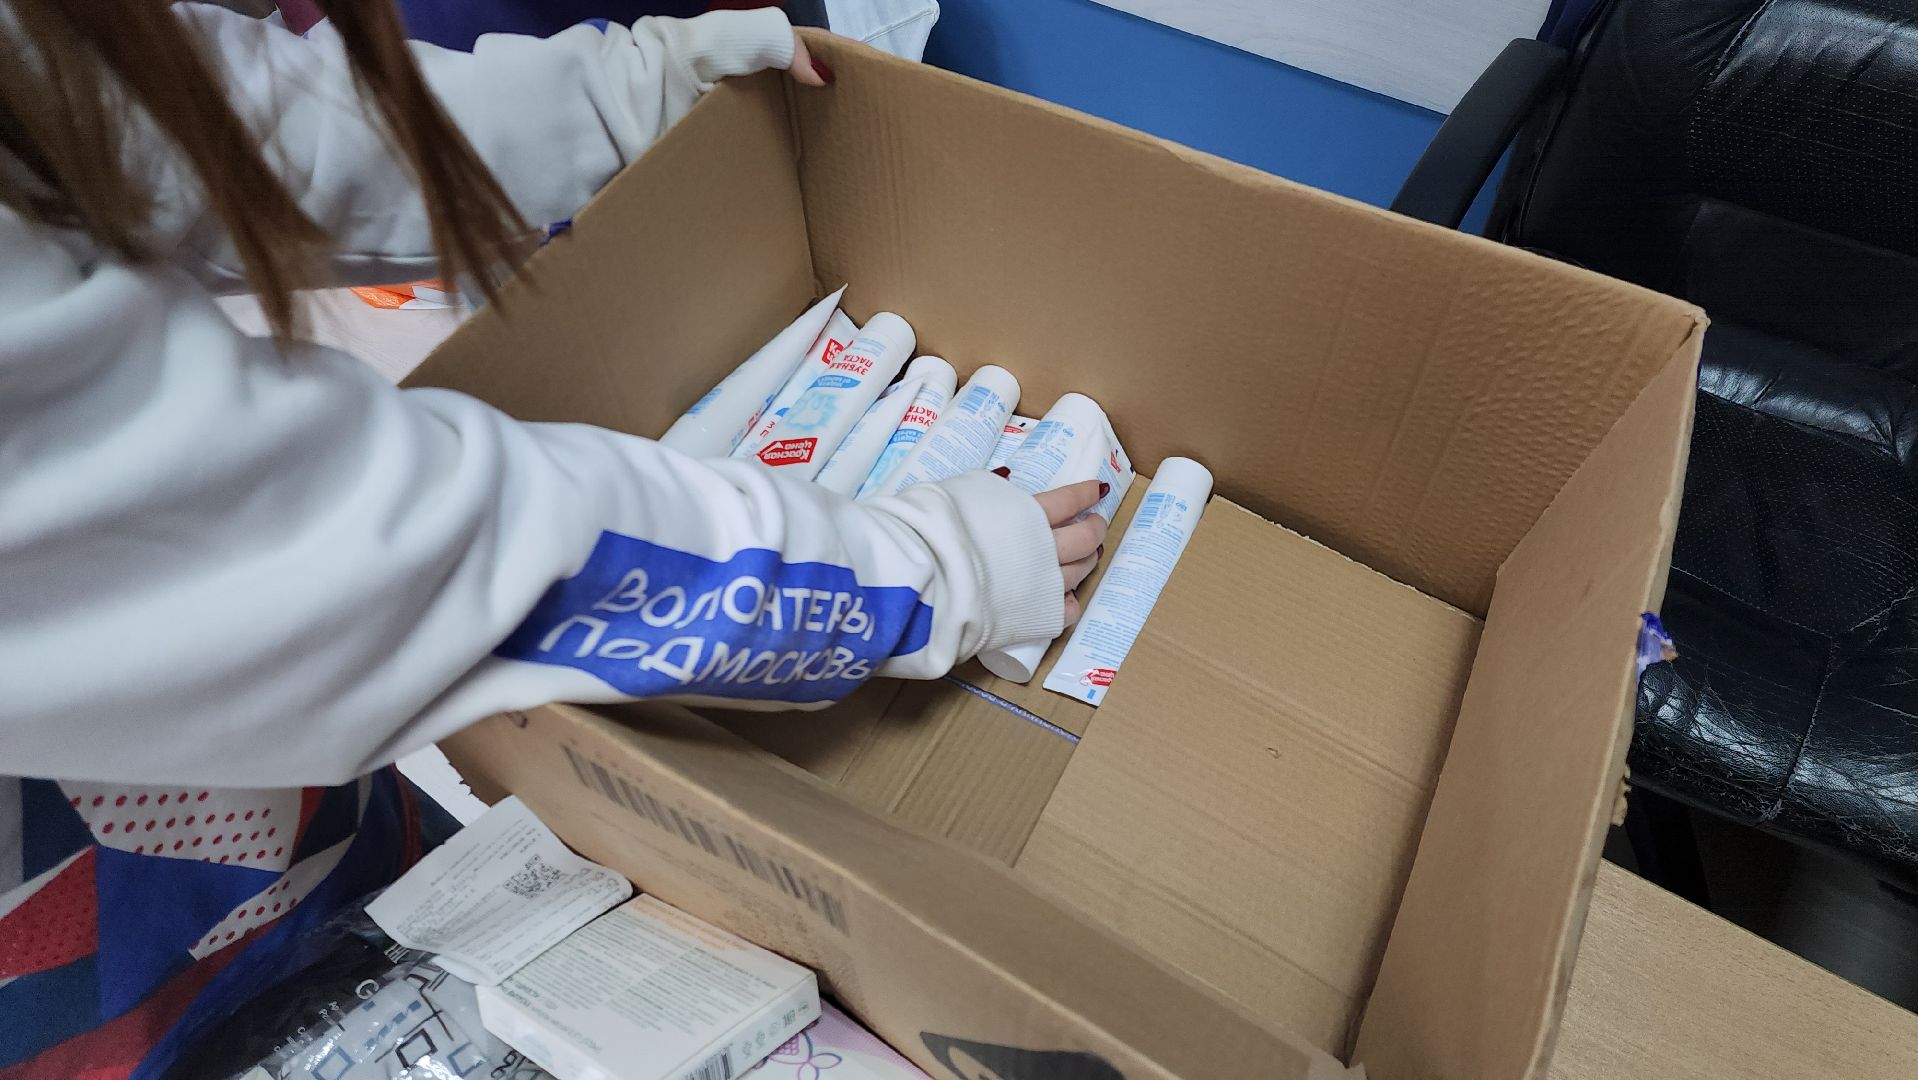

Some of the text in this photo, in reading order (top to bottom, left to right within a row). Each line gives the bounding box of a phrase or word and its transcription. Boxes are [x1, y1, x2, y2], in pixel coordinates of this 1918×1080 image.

[843, 354, 875, 368] ПАСТА
[903, 414, 934, 427] УБНА
[784, 440, 813, 451] цена
[763, 448, 811, 461] Красная
[592, 567, 875, 642] ВОЛОНТЕРЫ
[538, 614, 878, 686] ПОДМОСКОВЬ
